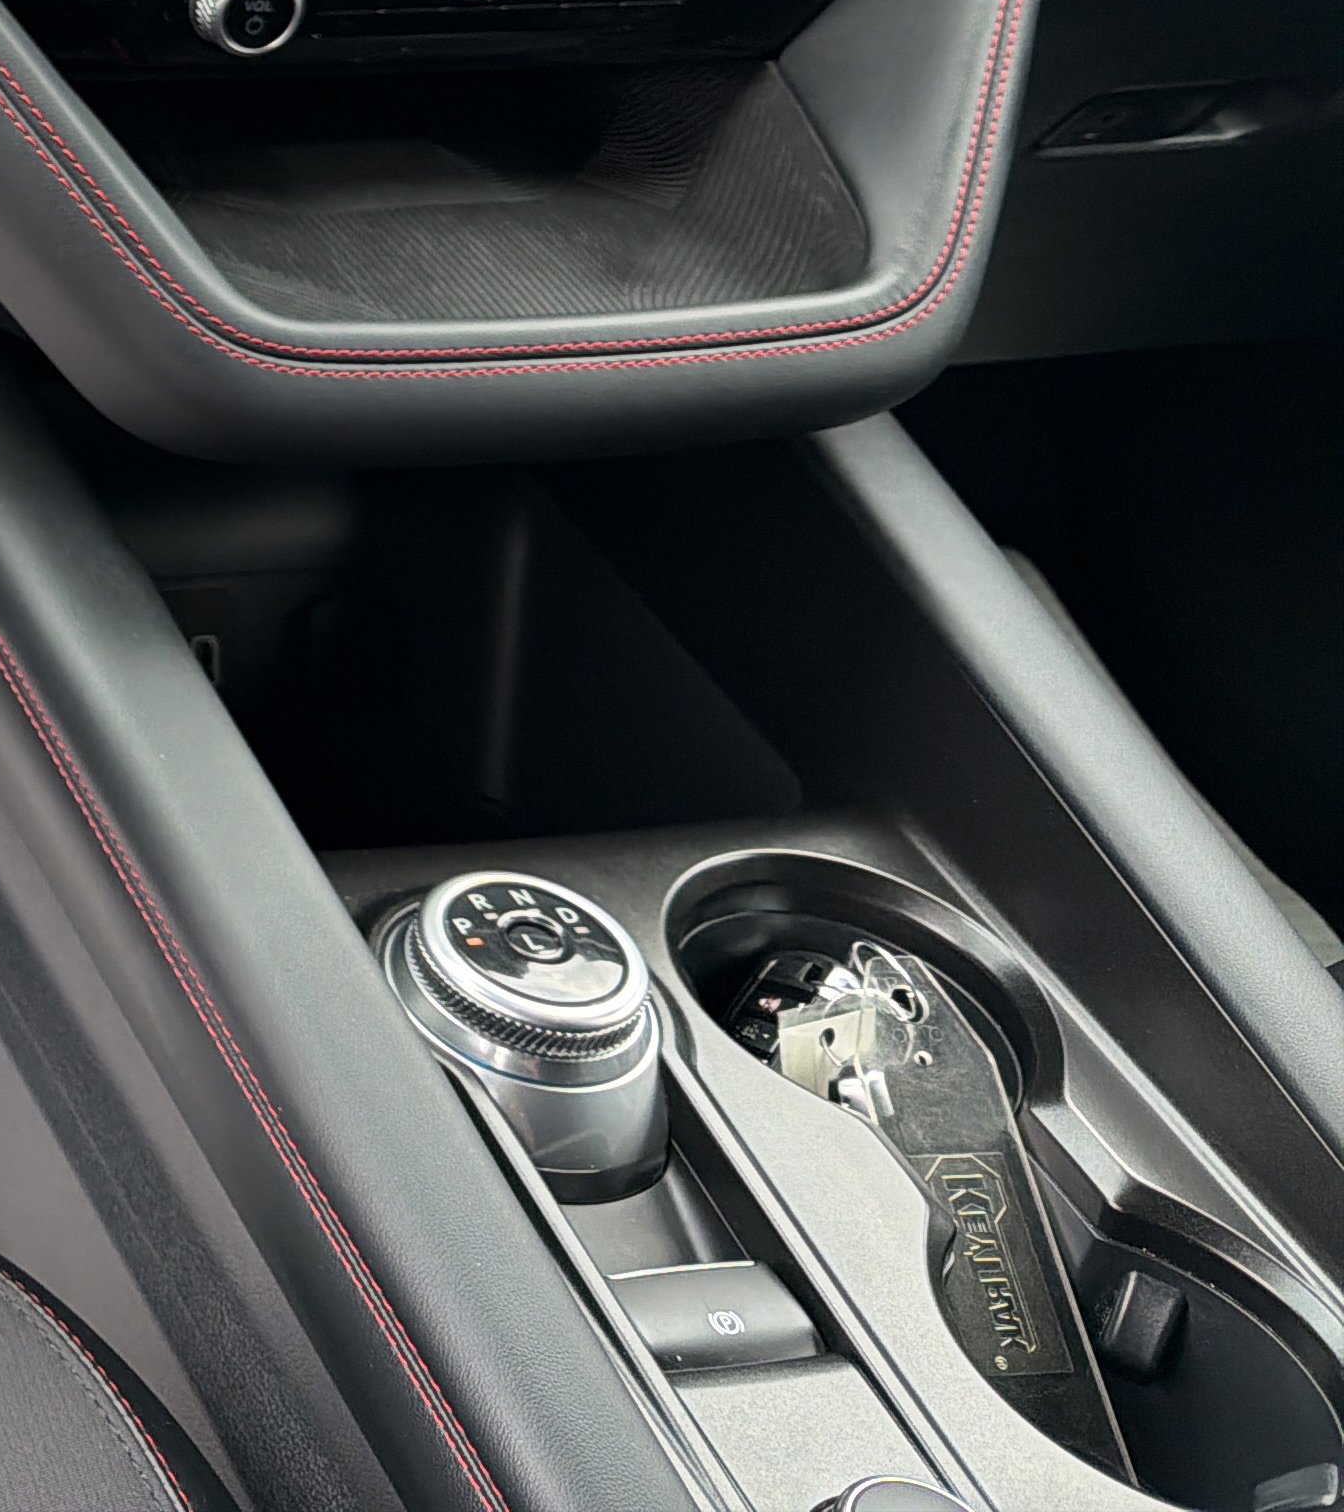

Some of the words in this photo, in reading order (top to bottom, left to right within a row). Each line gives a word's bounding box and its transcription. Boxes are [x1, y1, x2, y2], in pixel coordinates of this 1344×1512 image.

[244, 0, 276, 13] VOL
[466, 893, 495, 912] R
[507, 888, 537, 907] N
[554, 907, 581, 925] D
[451, 917, 474, 936] P
[520, 933, 546, 952] L
